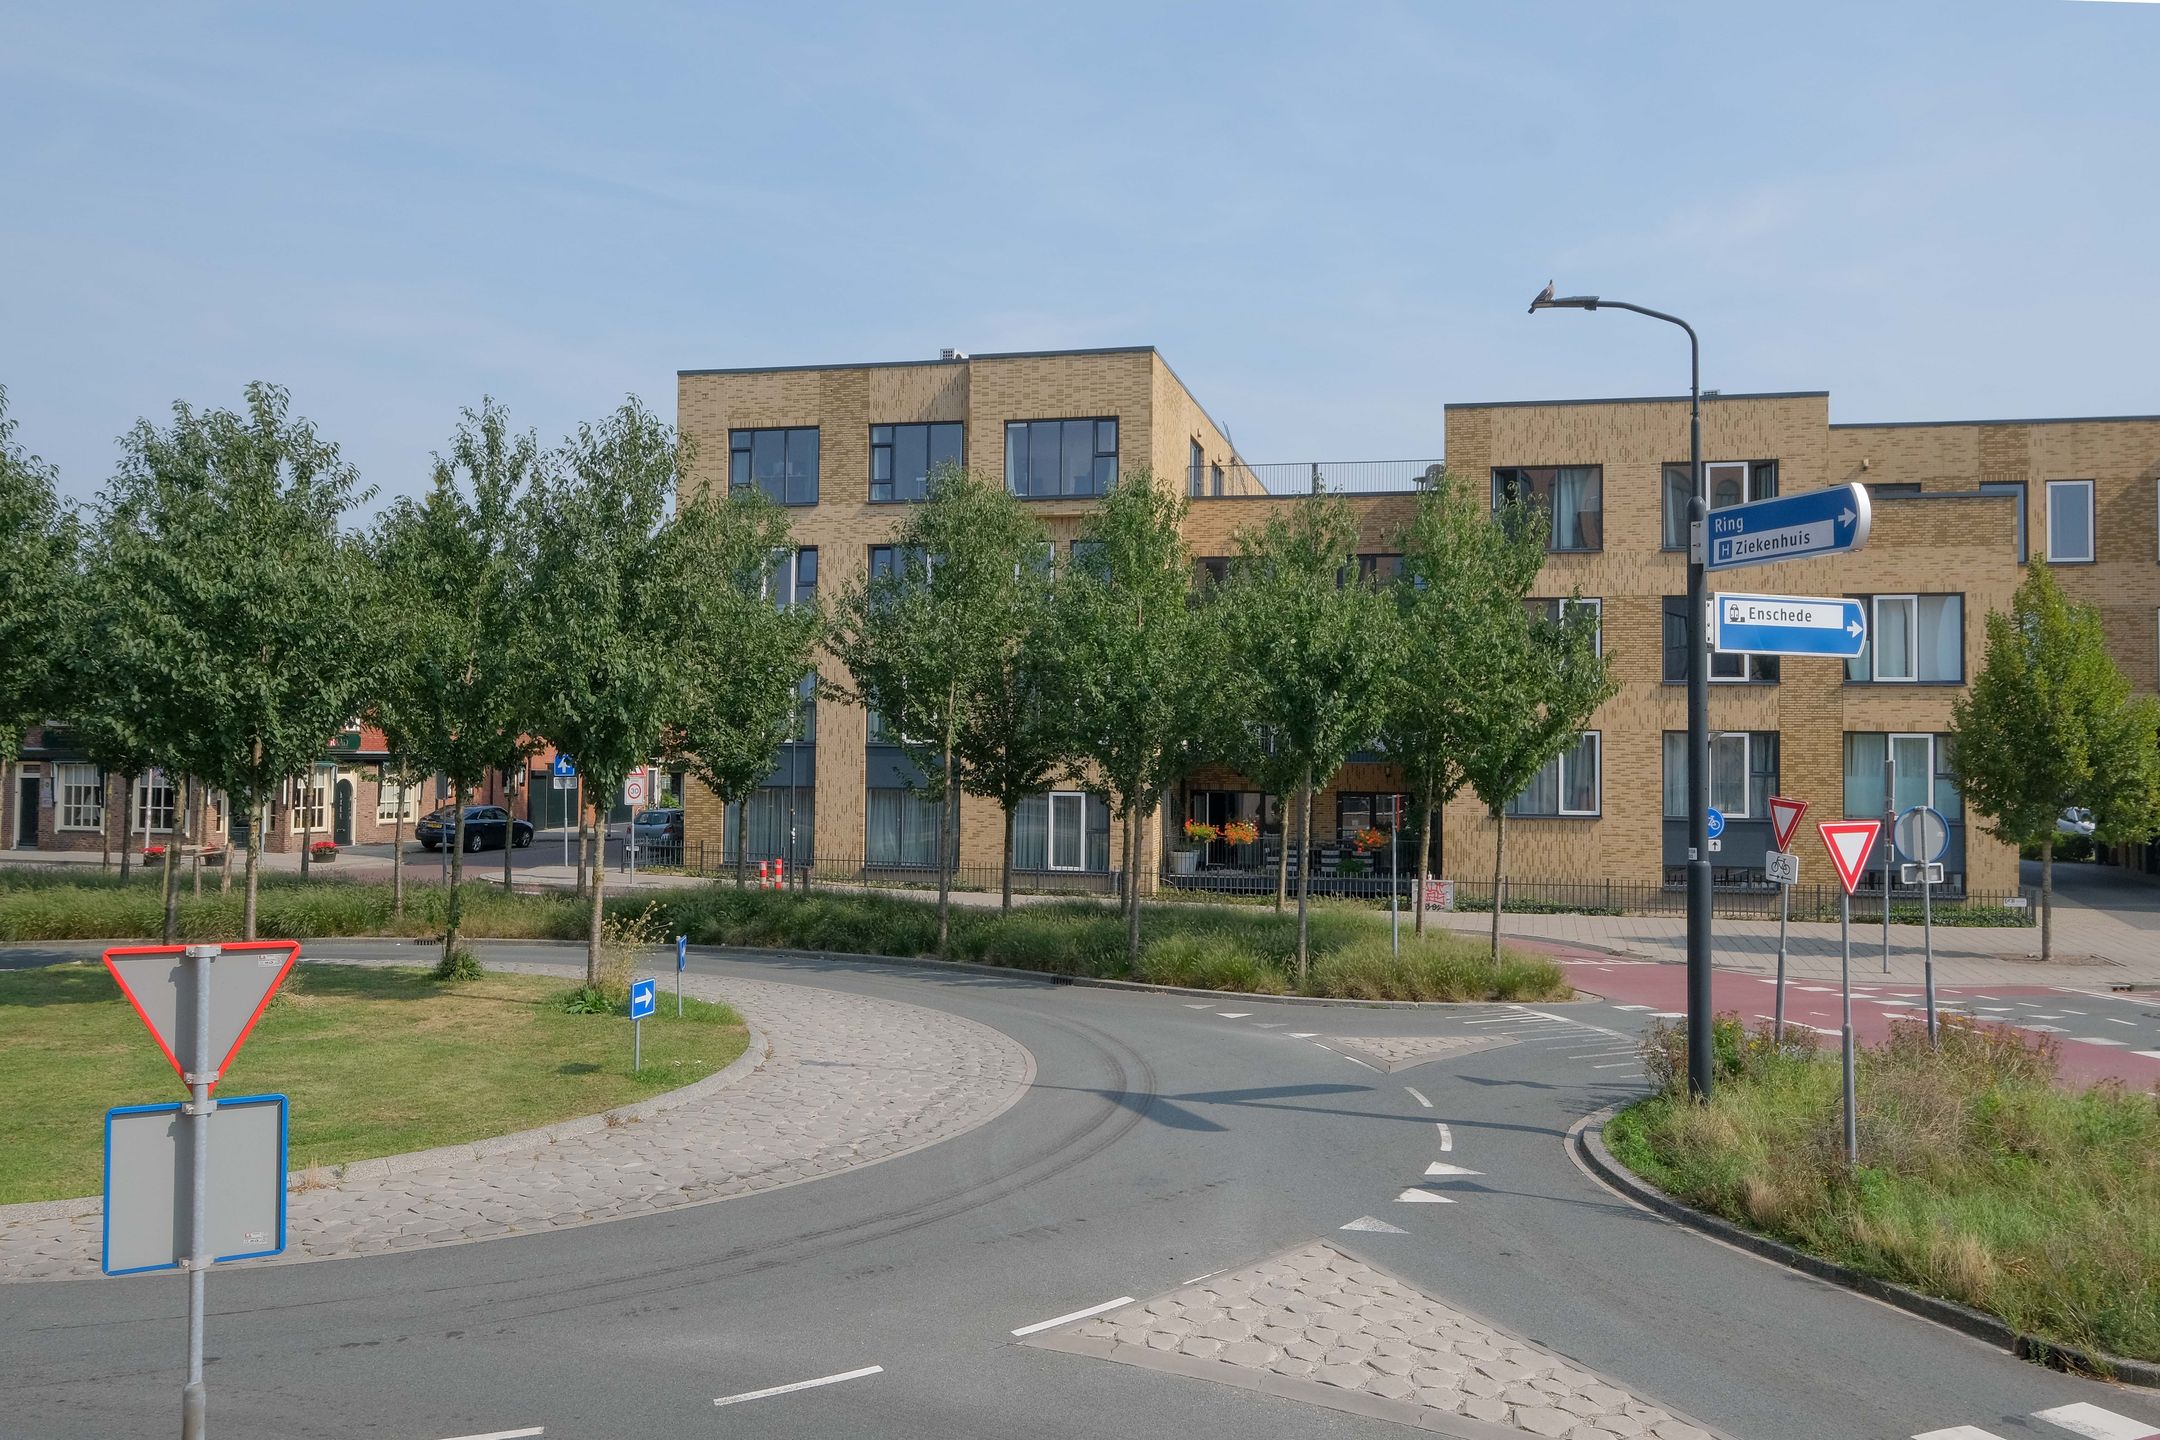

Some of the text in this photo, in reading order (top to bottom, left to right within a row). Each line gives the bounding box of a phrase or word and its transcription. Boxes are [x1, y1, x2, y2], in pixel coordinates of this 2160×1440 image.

[1714, 516, 1744, 533] Ring
[1721, 531, 1810, 557] H Ziekenhuis
[1749, 607, 1812, 622] Enschede
